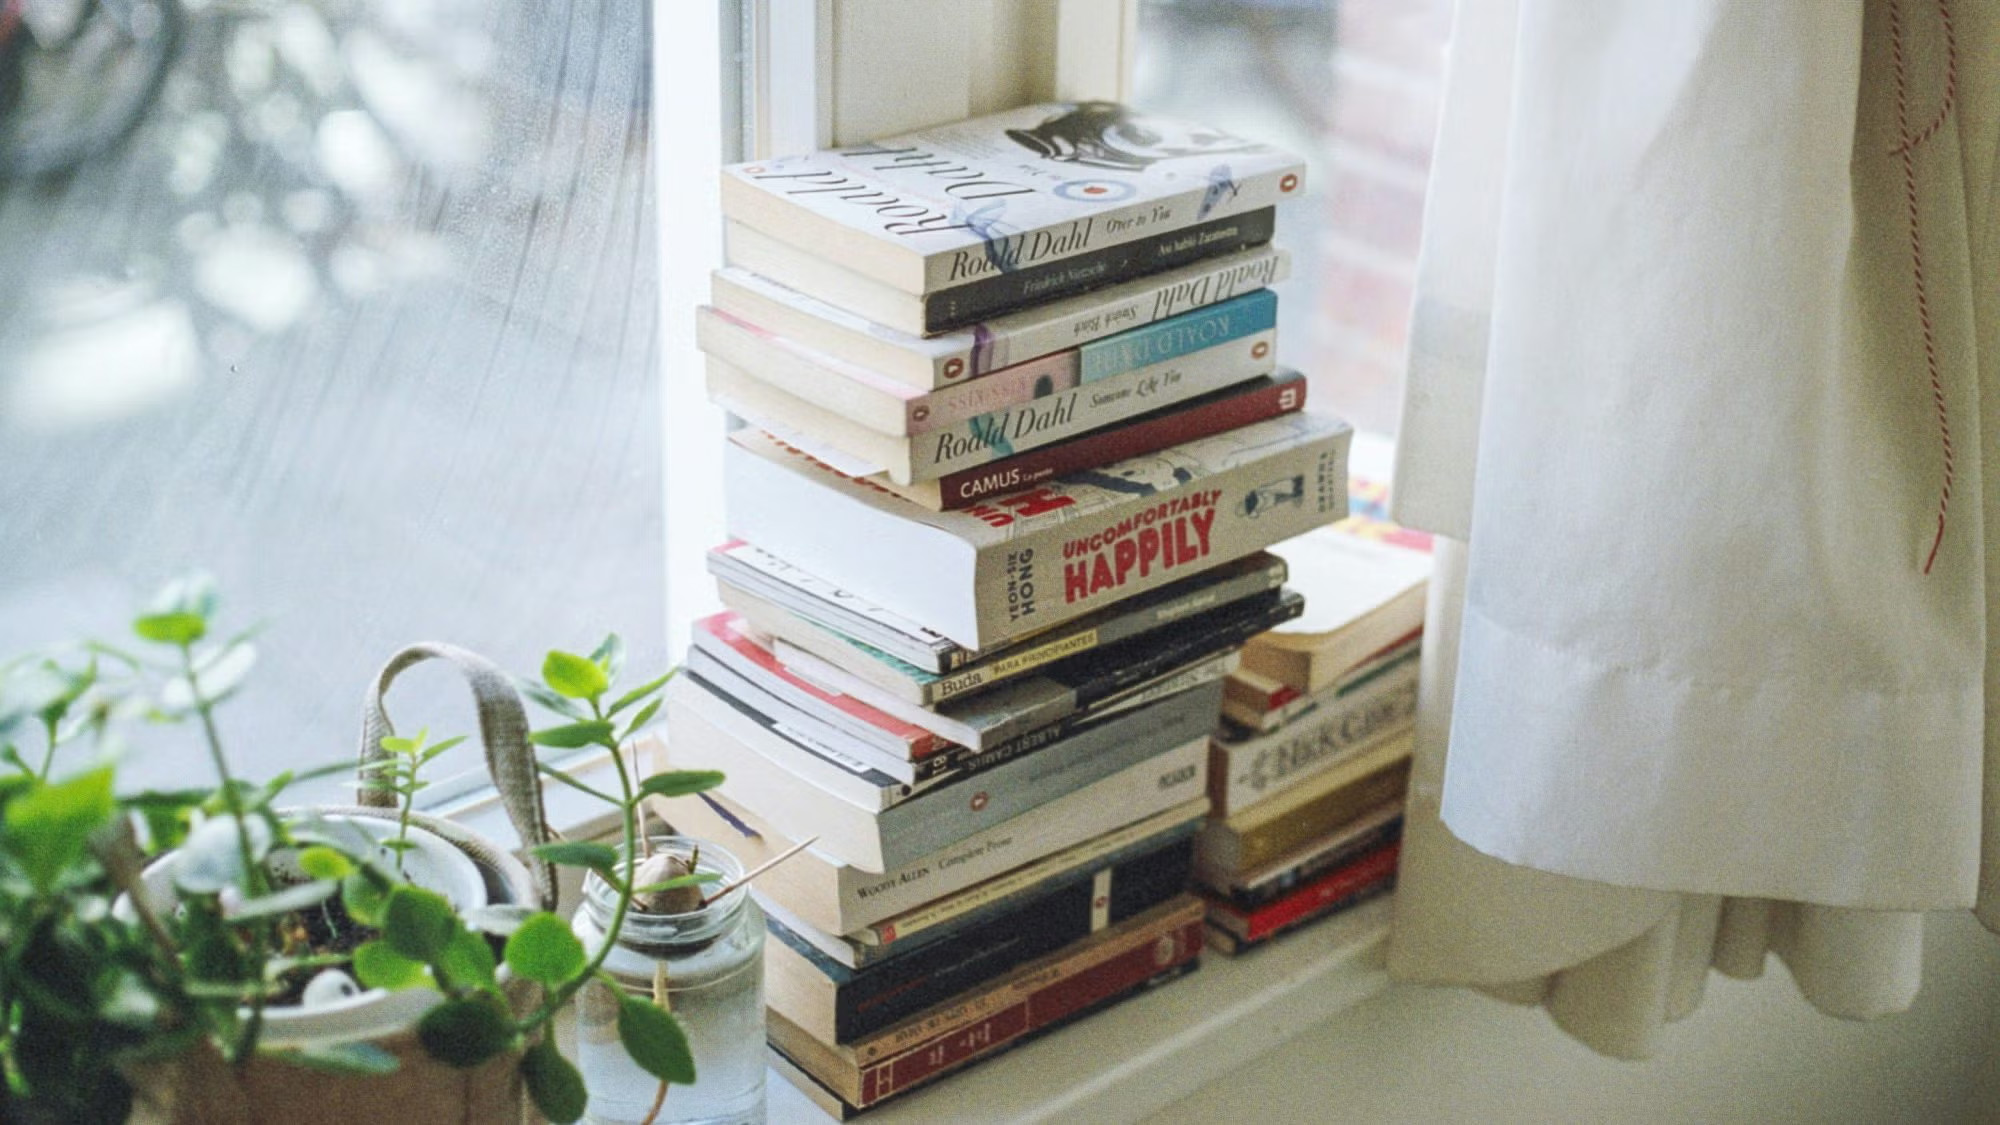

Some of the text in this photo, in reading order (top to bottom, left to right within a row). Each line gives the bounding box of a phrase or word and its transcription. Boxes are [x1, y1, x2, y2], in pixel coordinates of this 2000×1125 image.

[754, 171, 975, 235] Roald
[841, 147, 1037, 200] Dahl
[949, 235, 1025, 281] Roald
[1029, 218, 1094, 261] Dahl
[1213, 255, 1279, 300] Roald
[1150, 274, 1209, 322] Dahl
[934, 410, 1009, 464] Roald
[1013, 392, 1078, 437] Dahl
[960, 468, 1020, 498] CAMUS
[1062, 489, 1222, 561] UNCOMFORTABLY
[1064, 508, 1217, 604] HAPPILY
[1009, 552, 1019, 622] YEON-SIK
[1019, 547, 1034, 615] HONG
[941, 671, 983, 697] Buda
